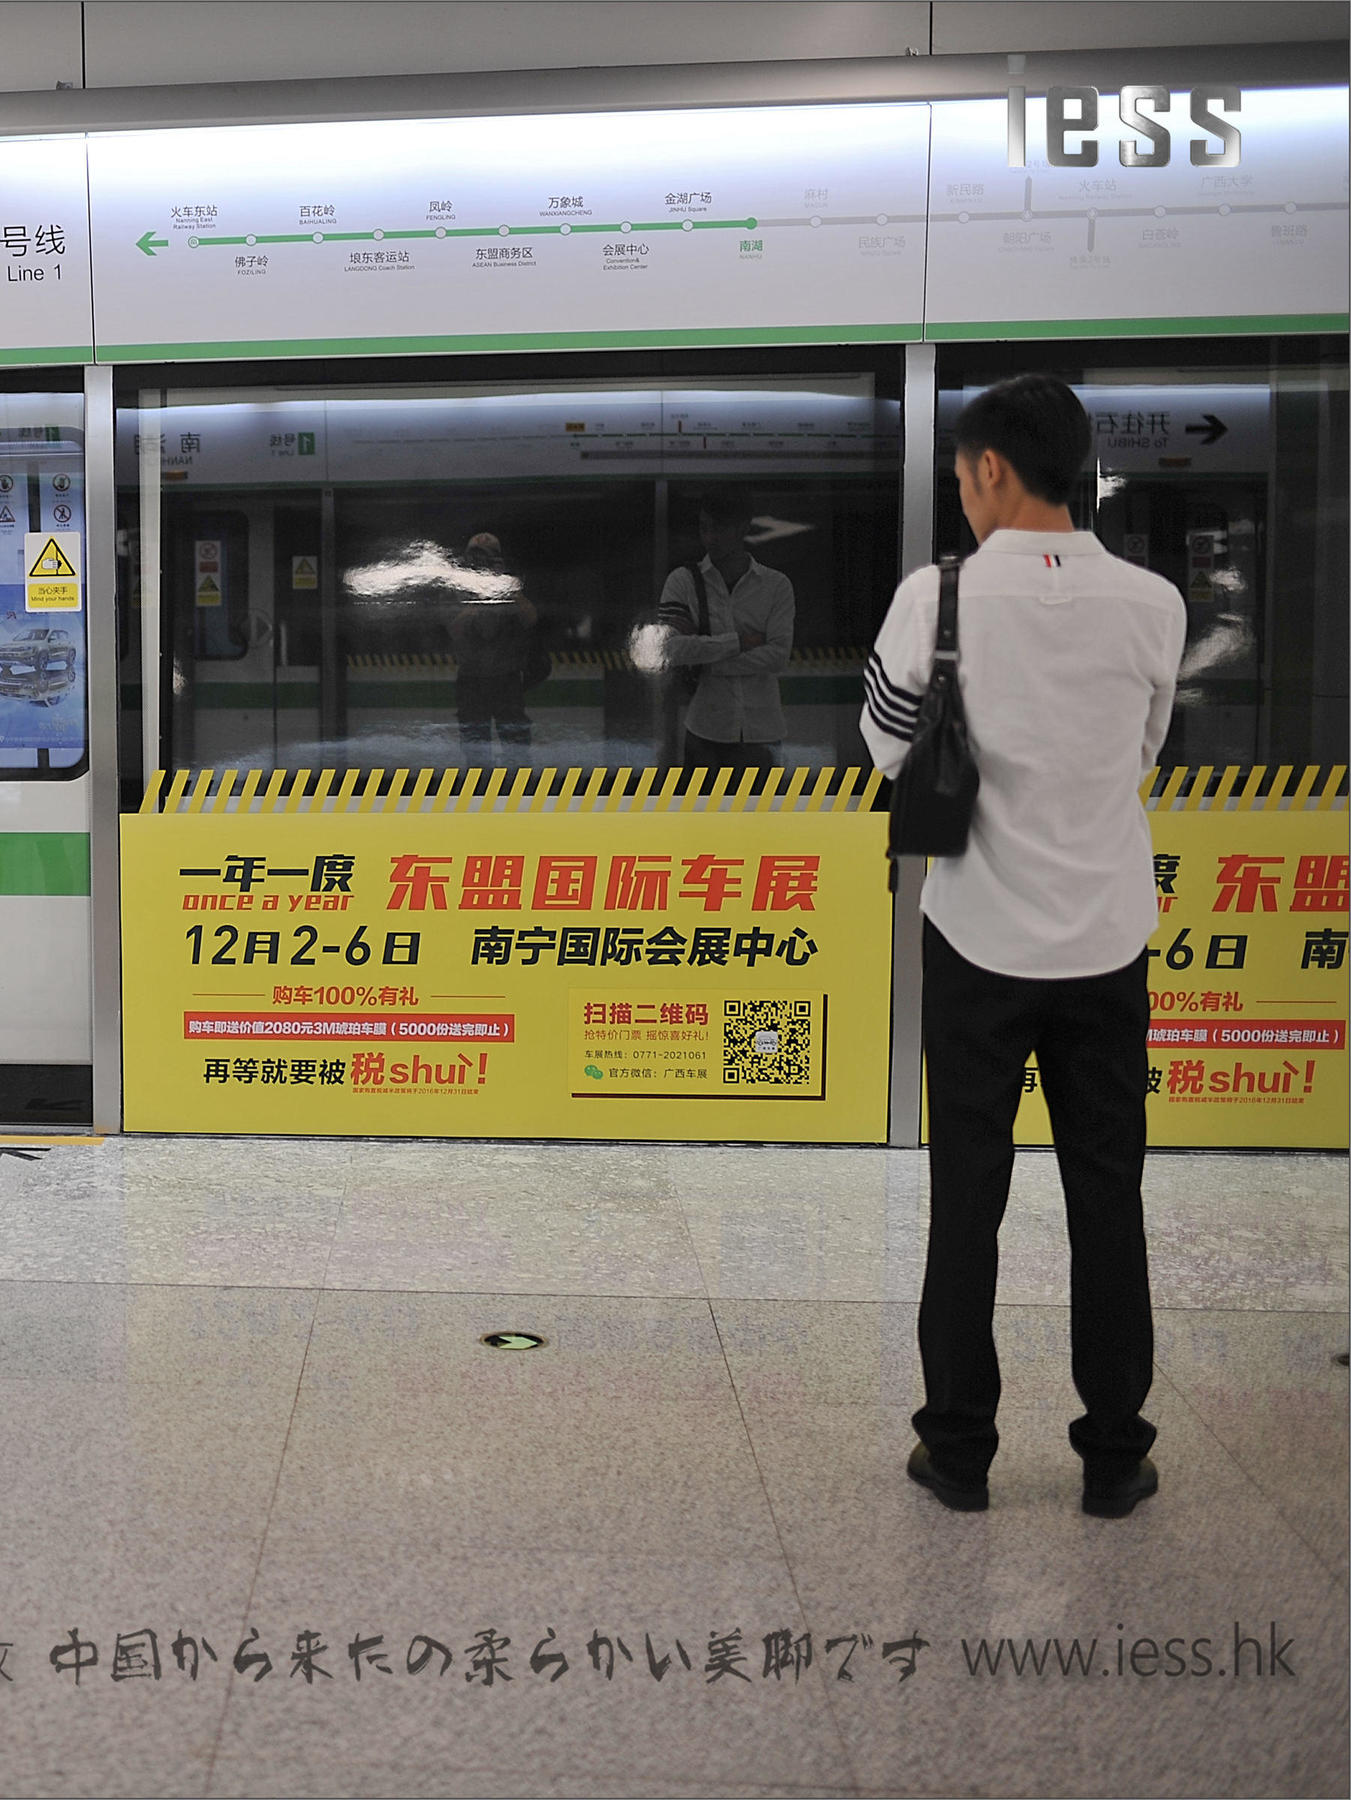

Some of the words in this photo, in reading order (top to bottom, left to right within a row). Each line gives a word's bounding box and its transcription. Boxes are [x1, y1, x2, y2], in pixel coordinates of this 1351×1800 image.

[548, 196, 584, 209] 万象城
[665, 192, 712, 205] 金湖广场
[171, 205, 218, 217] 火车东站
[299, 204, 335, 217] 百花岭
[429, 201, 453, 213] 凤岭
[603, 243, 649, 256] 会展中心
[739, 240, 763, 252] 南湖
[349, 251, 410, 264] 埌东客运站
[476, 247, 533, 260] 东盟商务区
[234, 256, 269, 268] 佛子岭
[7, 264, 45, 282] Line
[54, 264, 62, 281] 1
[179, 854, 356, 892] 一年一度
[386, 854, 821, 911] 东盟国际车展
[182, 894, 253, 911] once
[262, 895, 280, 911] a
[288, 894, 355, 912] year
[185, 925, 421, 966] 12月2-6日
[471, 925, 819, 967] 南宁国际会展中心
[272, 985, 419, 1006] 购车100%有礼
[1147, 991, 1244, 1013] 00%有礼
[583, 1002, 709, 1026] 扫描二维码
[584, 1029, 642, 1041] 抢特价门票
